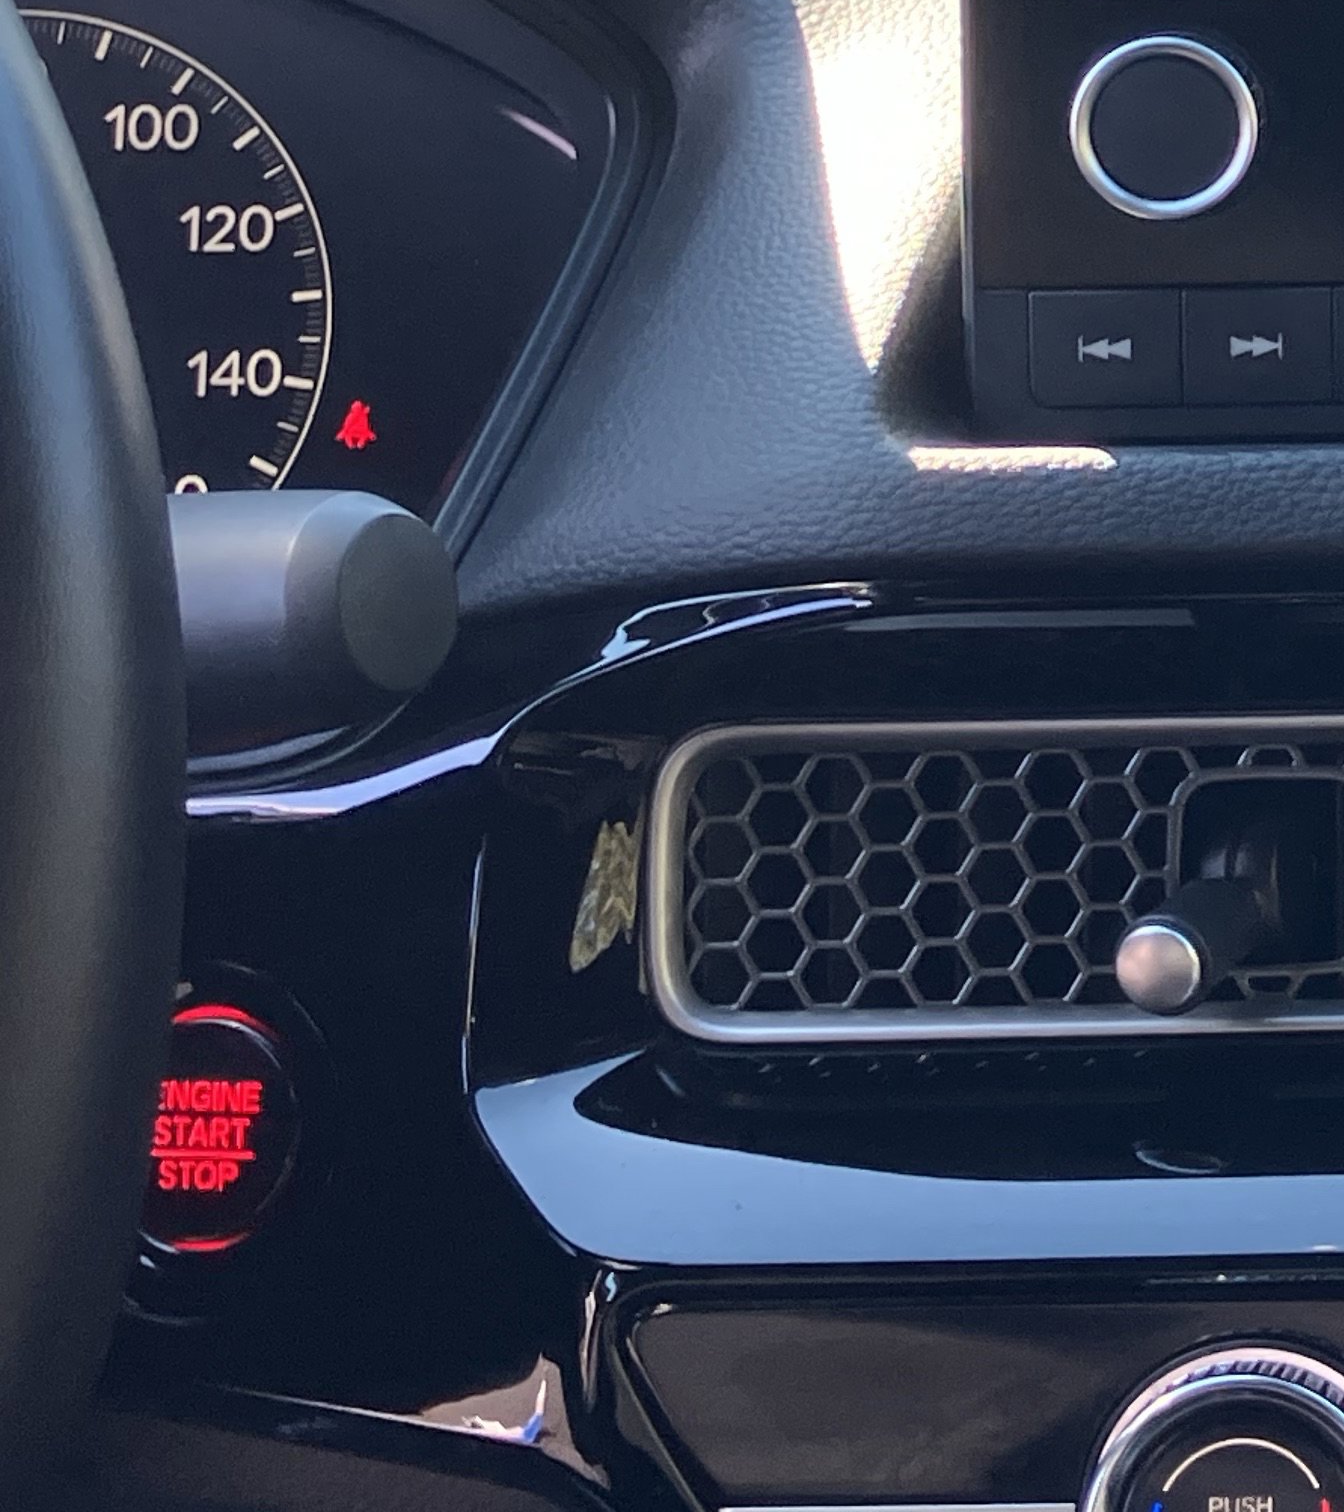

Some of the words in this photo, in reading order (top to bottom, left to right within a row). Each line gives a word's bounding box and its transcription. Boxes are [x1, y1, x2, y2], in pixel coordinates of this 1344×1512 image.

[105, 105, 198, 150] 100
[180, 205, 273, 251] 120
[188, 350, 282, 396] 140
[153, 1114, 251, 1149] START
[158, 1159, 239, 1191] STOP
[1209, 1497, 1272, 1512] PUSH
